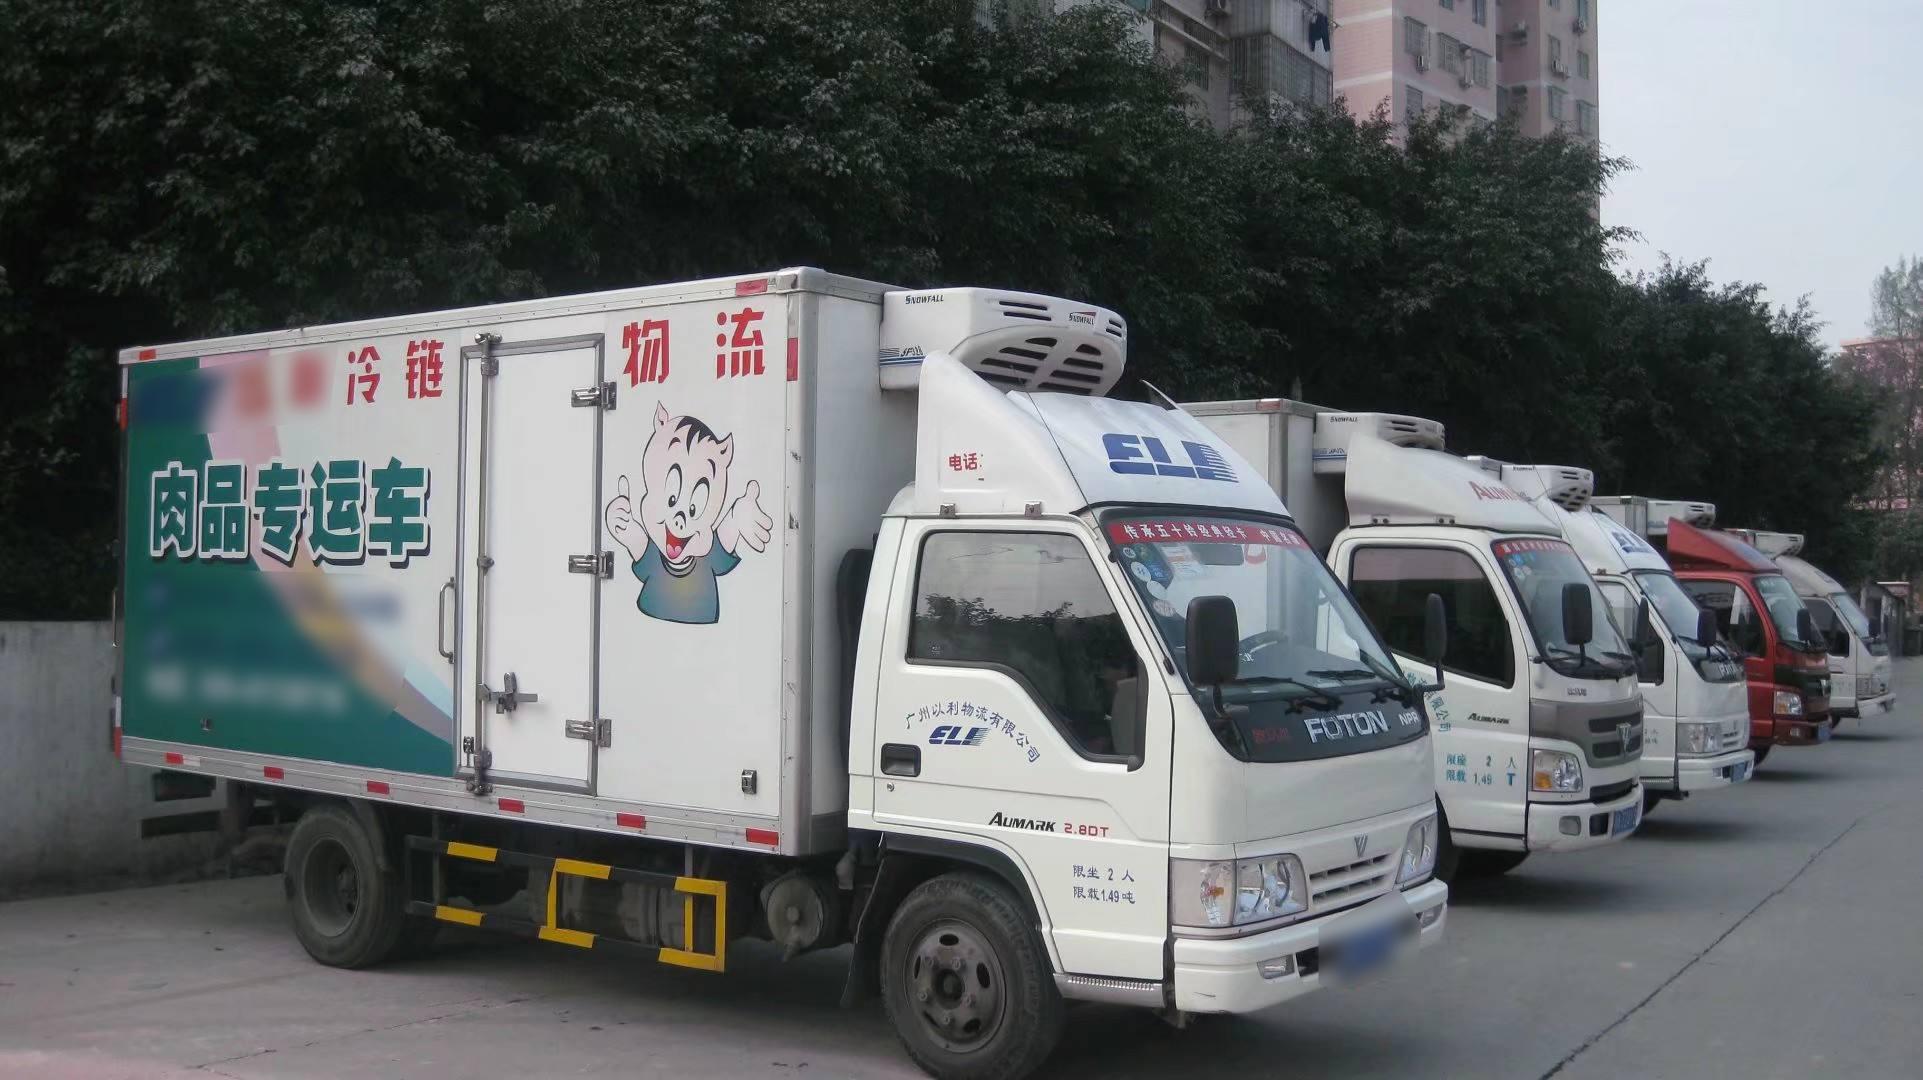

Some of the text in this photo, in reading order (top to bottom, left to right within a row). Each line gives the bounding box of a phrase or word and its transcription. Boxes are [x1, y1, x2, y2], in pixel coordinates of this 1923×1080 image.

[905, 295, 945, 305] SNOWFALL
[1069, 312, 1095, 326] SNOWFALL
[346, 340, 445, 405] 冷链
[150, 456, 430, 569] 肉品专运车
[905, 700, 1040, 763] 广州以利物流有限公司
[1303, 709, 1389, 744] FOTON
[1399, 711, 1420, 726] NPR
[988, 811, 1109, 837] AUMARK 2.8DT
